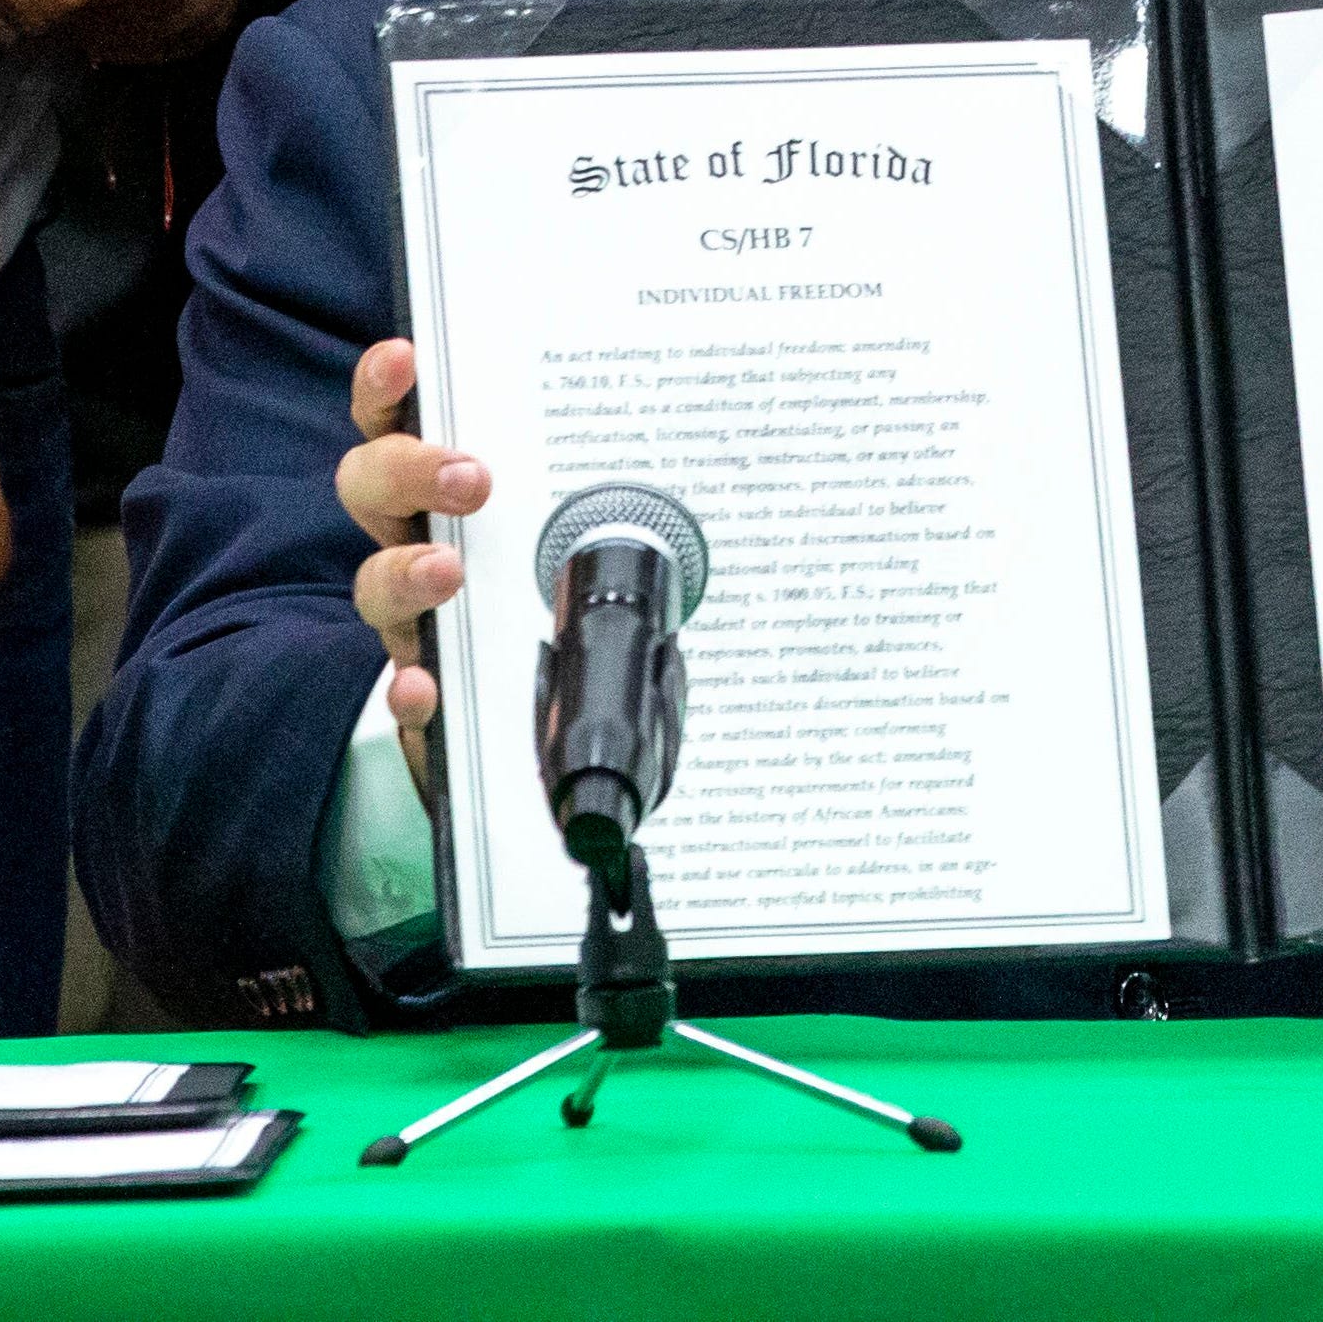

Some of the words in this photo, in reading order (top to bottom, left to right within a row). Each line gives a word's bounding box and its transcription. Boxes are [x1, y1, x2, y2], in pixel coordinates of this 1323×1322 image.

[569, 152, 688, 194] State
[708, 141, 742, 178] of
[763, 137, 931, 187] Florida
[700, 226, 790, 254] CS/HB
[800, 226, 813, 247] 7
[638, 285, 770, 305] INDIVIDUAL
[778, 282, 882, 300] FREEDOM
